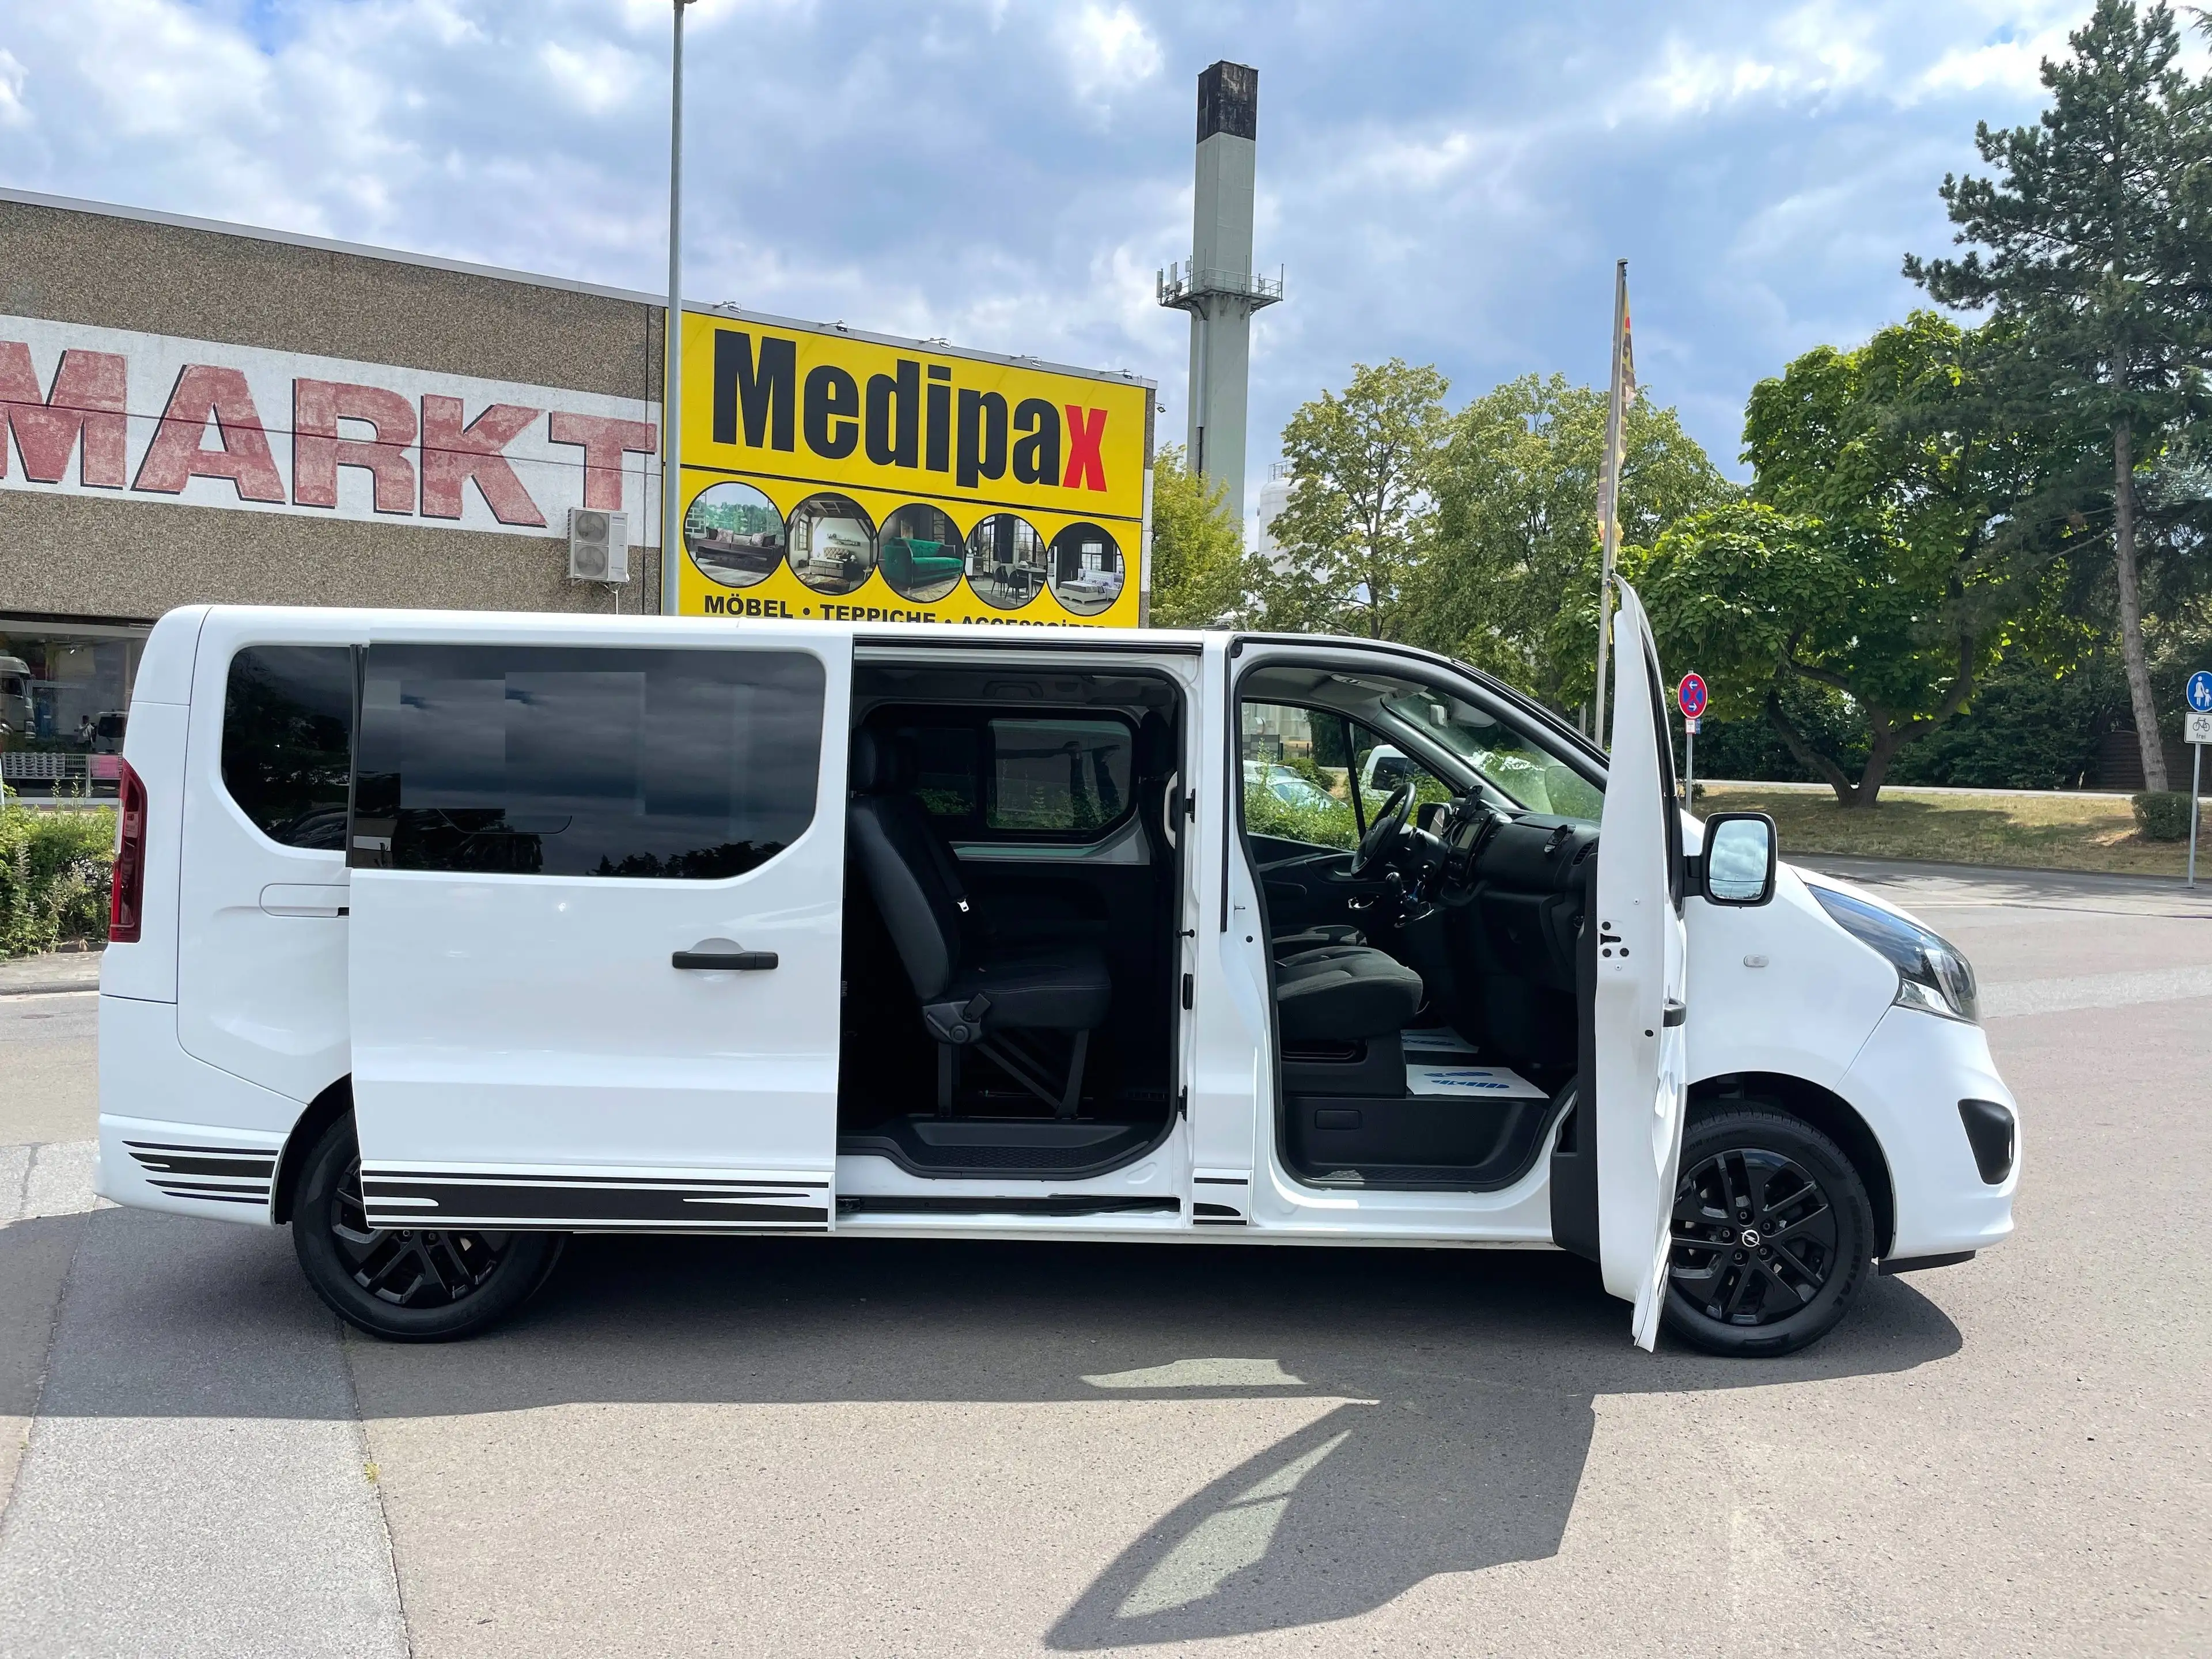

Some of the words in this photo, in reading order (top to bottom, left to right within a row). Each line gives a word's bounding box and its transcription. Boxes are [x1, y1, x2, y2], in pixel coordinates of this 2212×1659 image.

[0, 341, 657, 527] MARKT
[713, 328, 1108, 492] Medipax
[704, 593, 793, 619] MÖBEL
[820, 604, 935, 623] TEPPICHE
